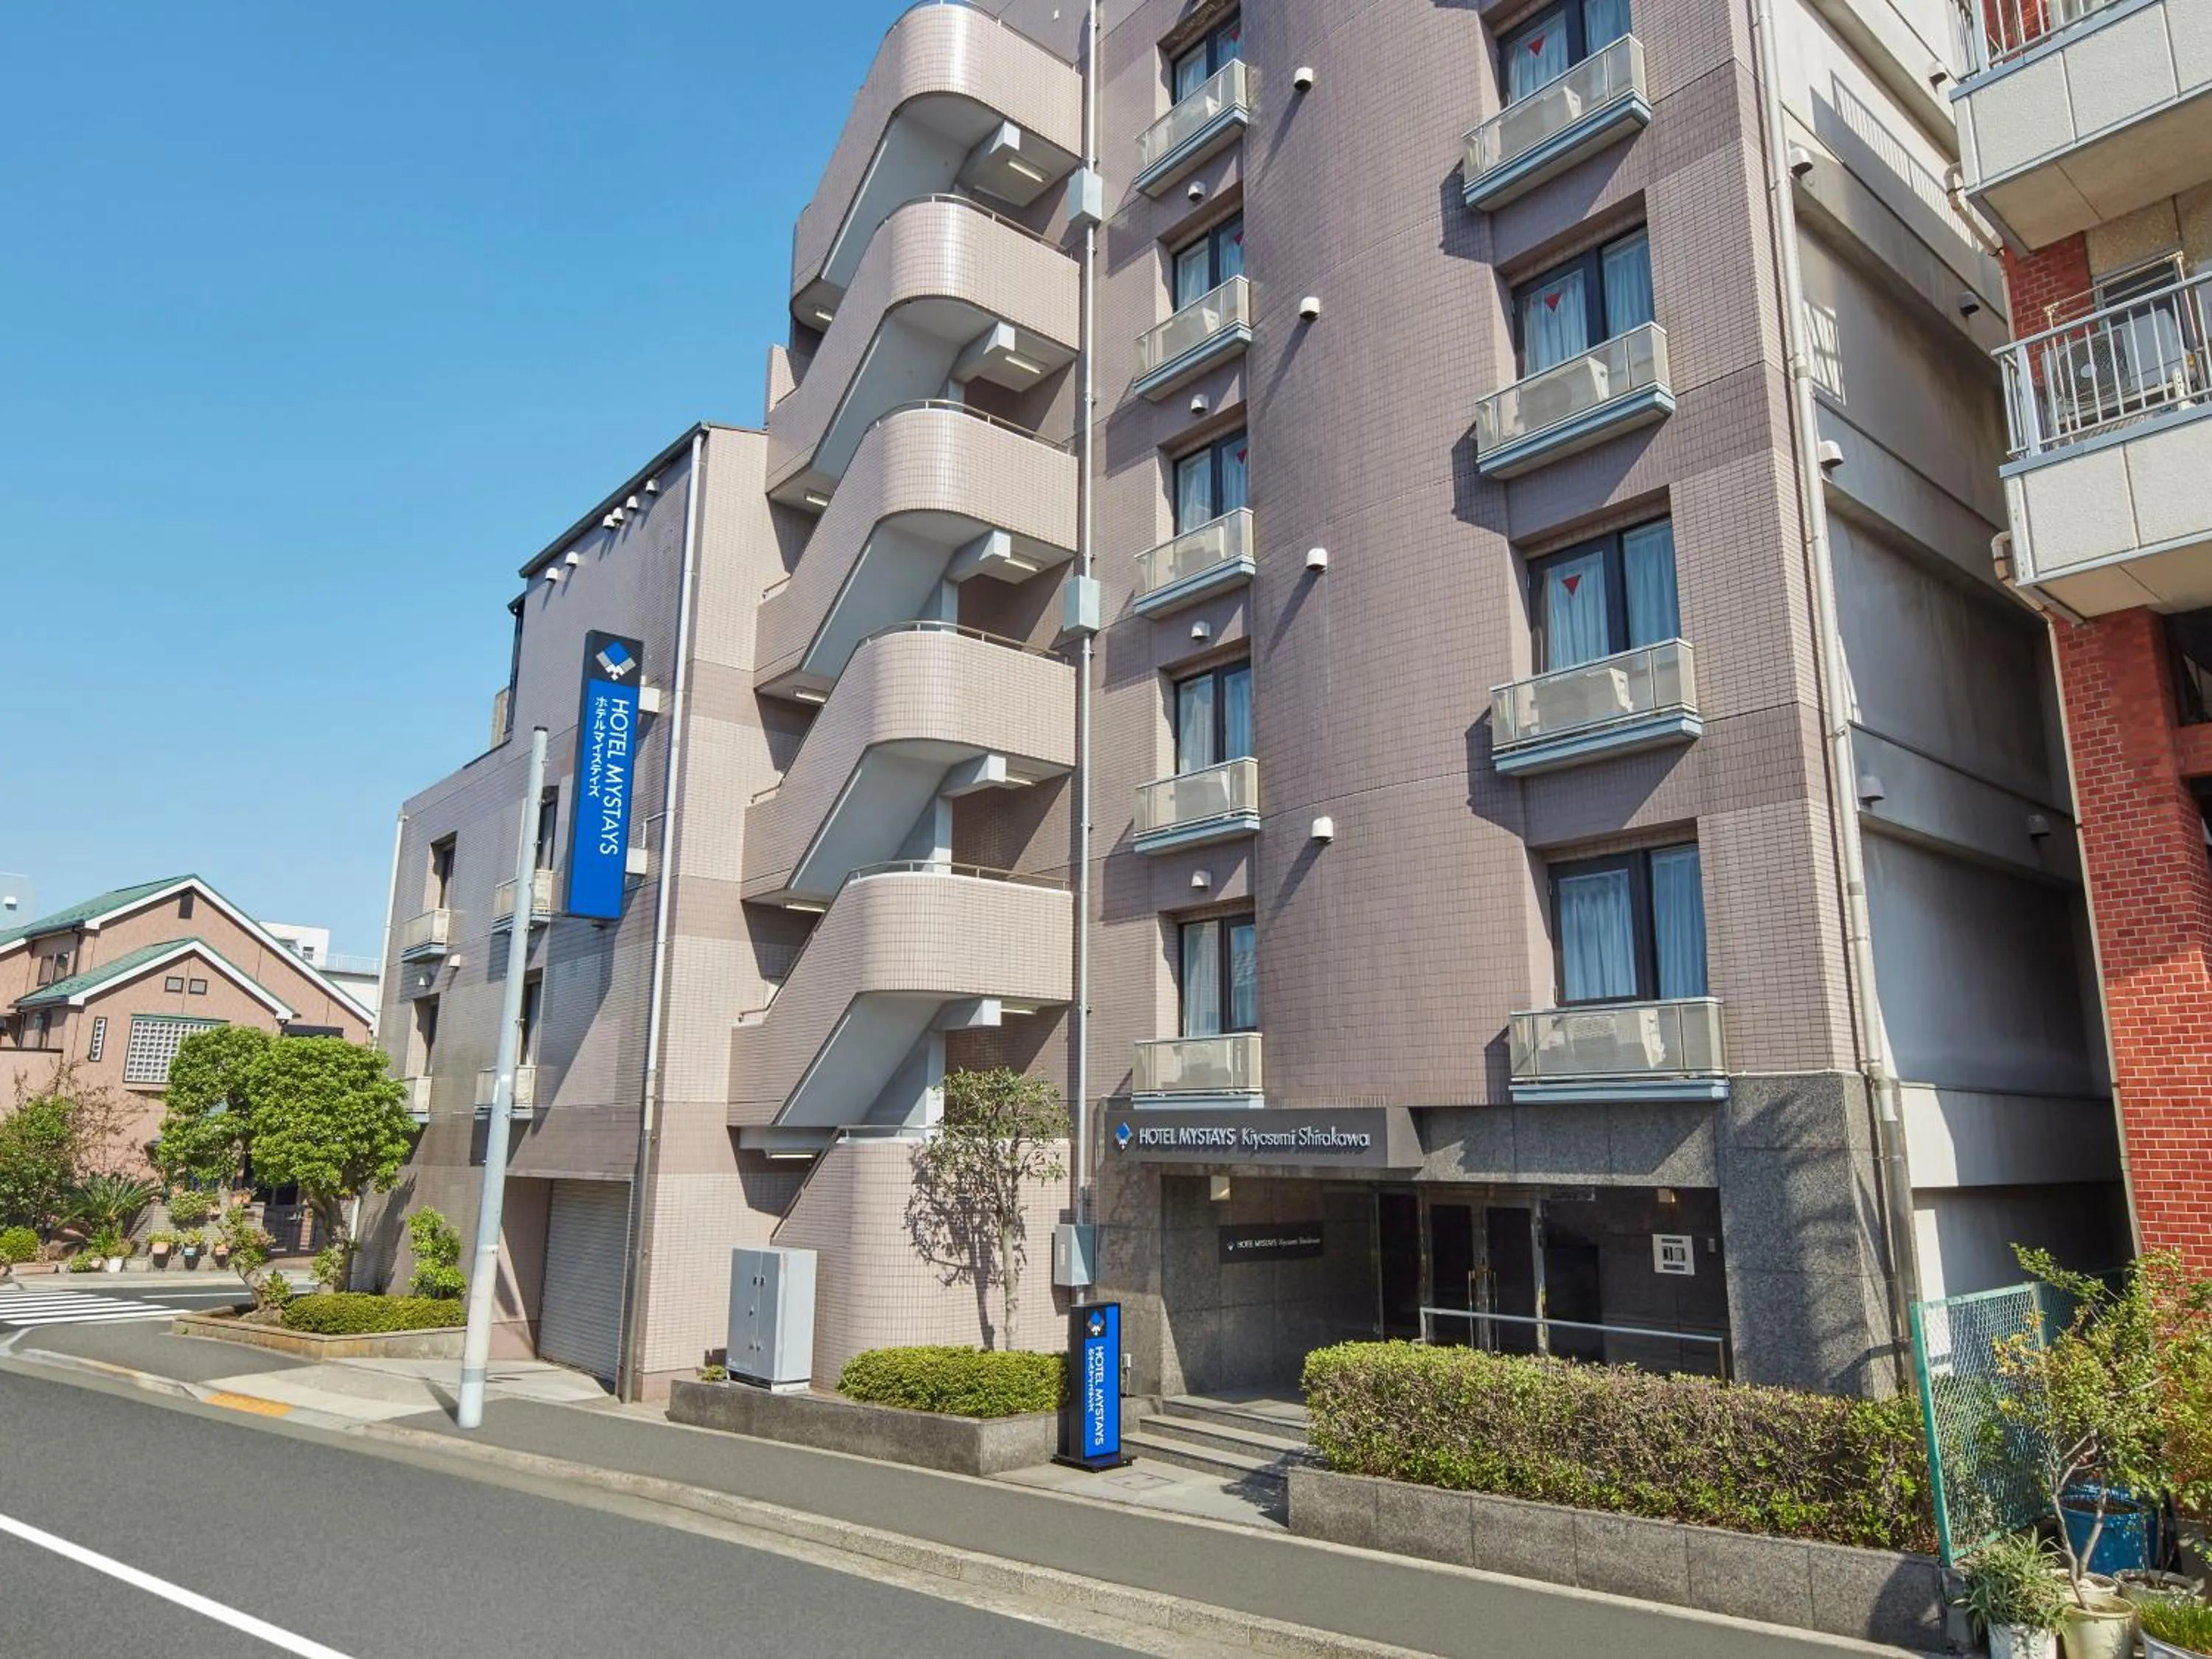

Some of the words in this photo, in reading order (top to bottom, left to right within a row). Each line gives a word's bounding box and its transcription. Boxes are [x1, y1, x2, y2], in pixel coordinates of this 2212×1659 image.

[607, 698, 630, 759] HOTEL
[599, 763, 625, 855] MYSTAYS
[1139, 1127, 1177, 1144] HOTEL
[1179, 1127, 1236, 1145] MYSTAYS
[1242, 1127, 1295, 1150] Kiyosumi
[1298, 1126, 1371, 1147] Shirakawa
[1095, 1346, 1104, 1386] HOTEL
[1095, 1388, 1104, 1446] MYSTAYS
